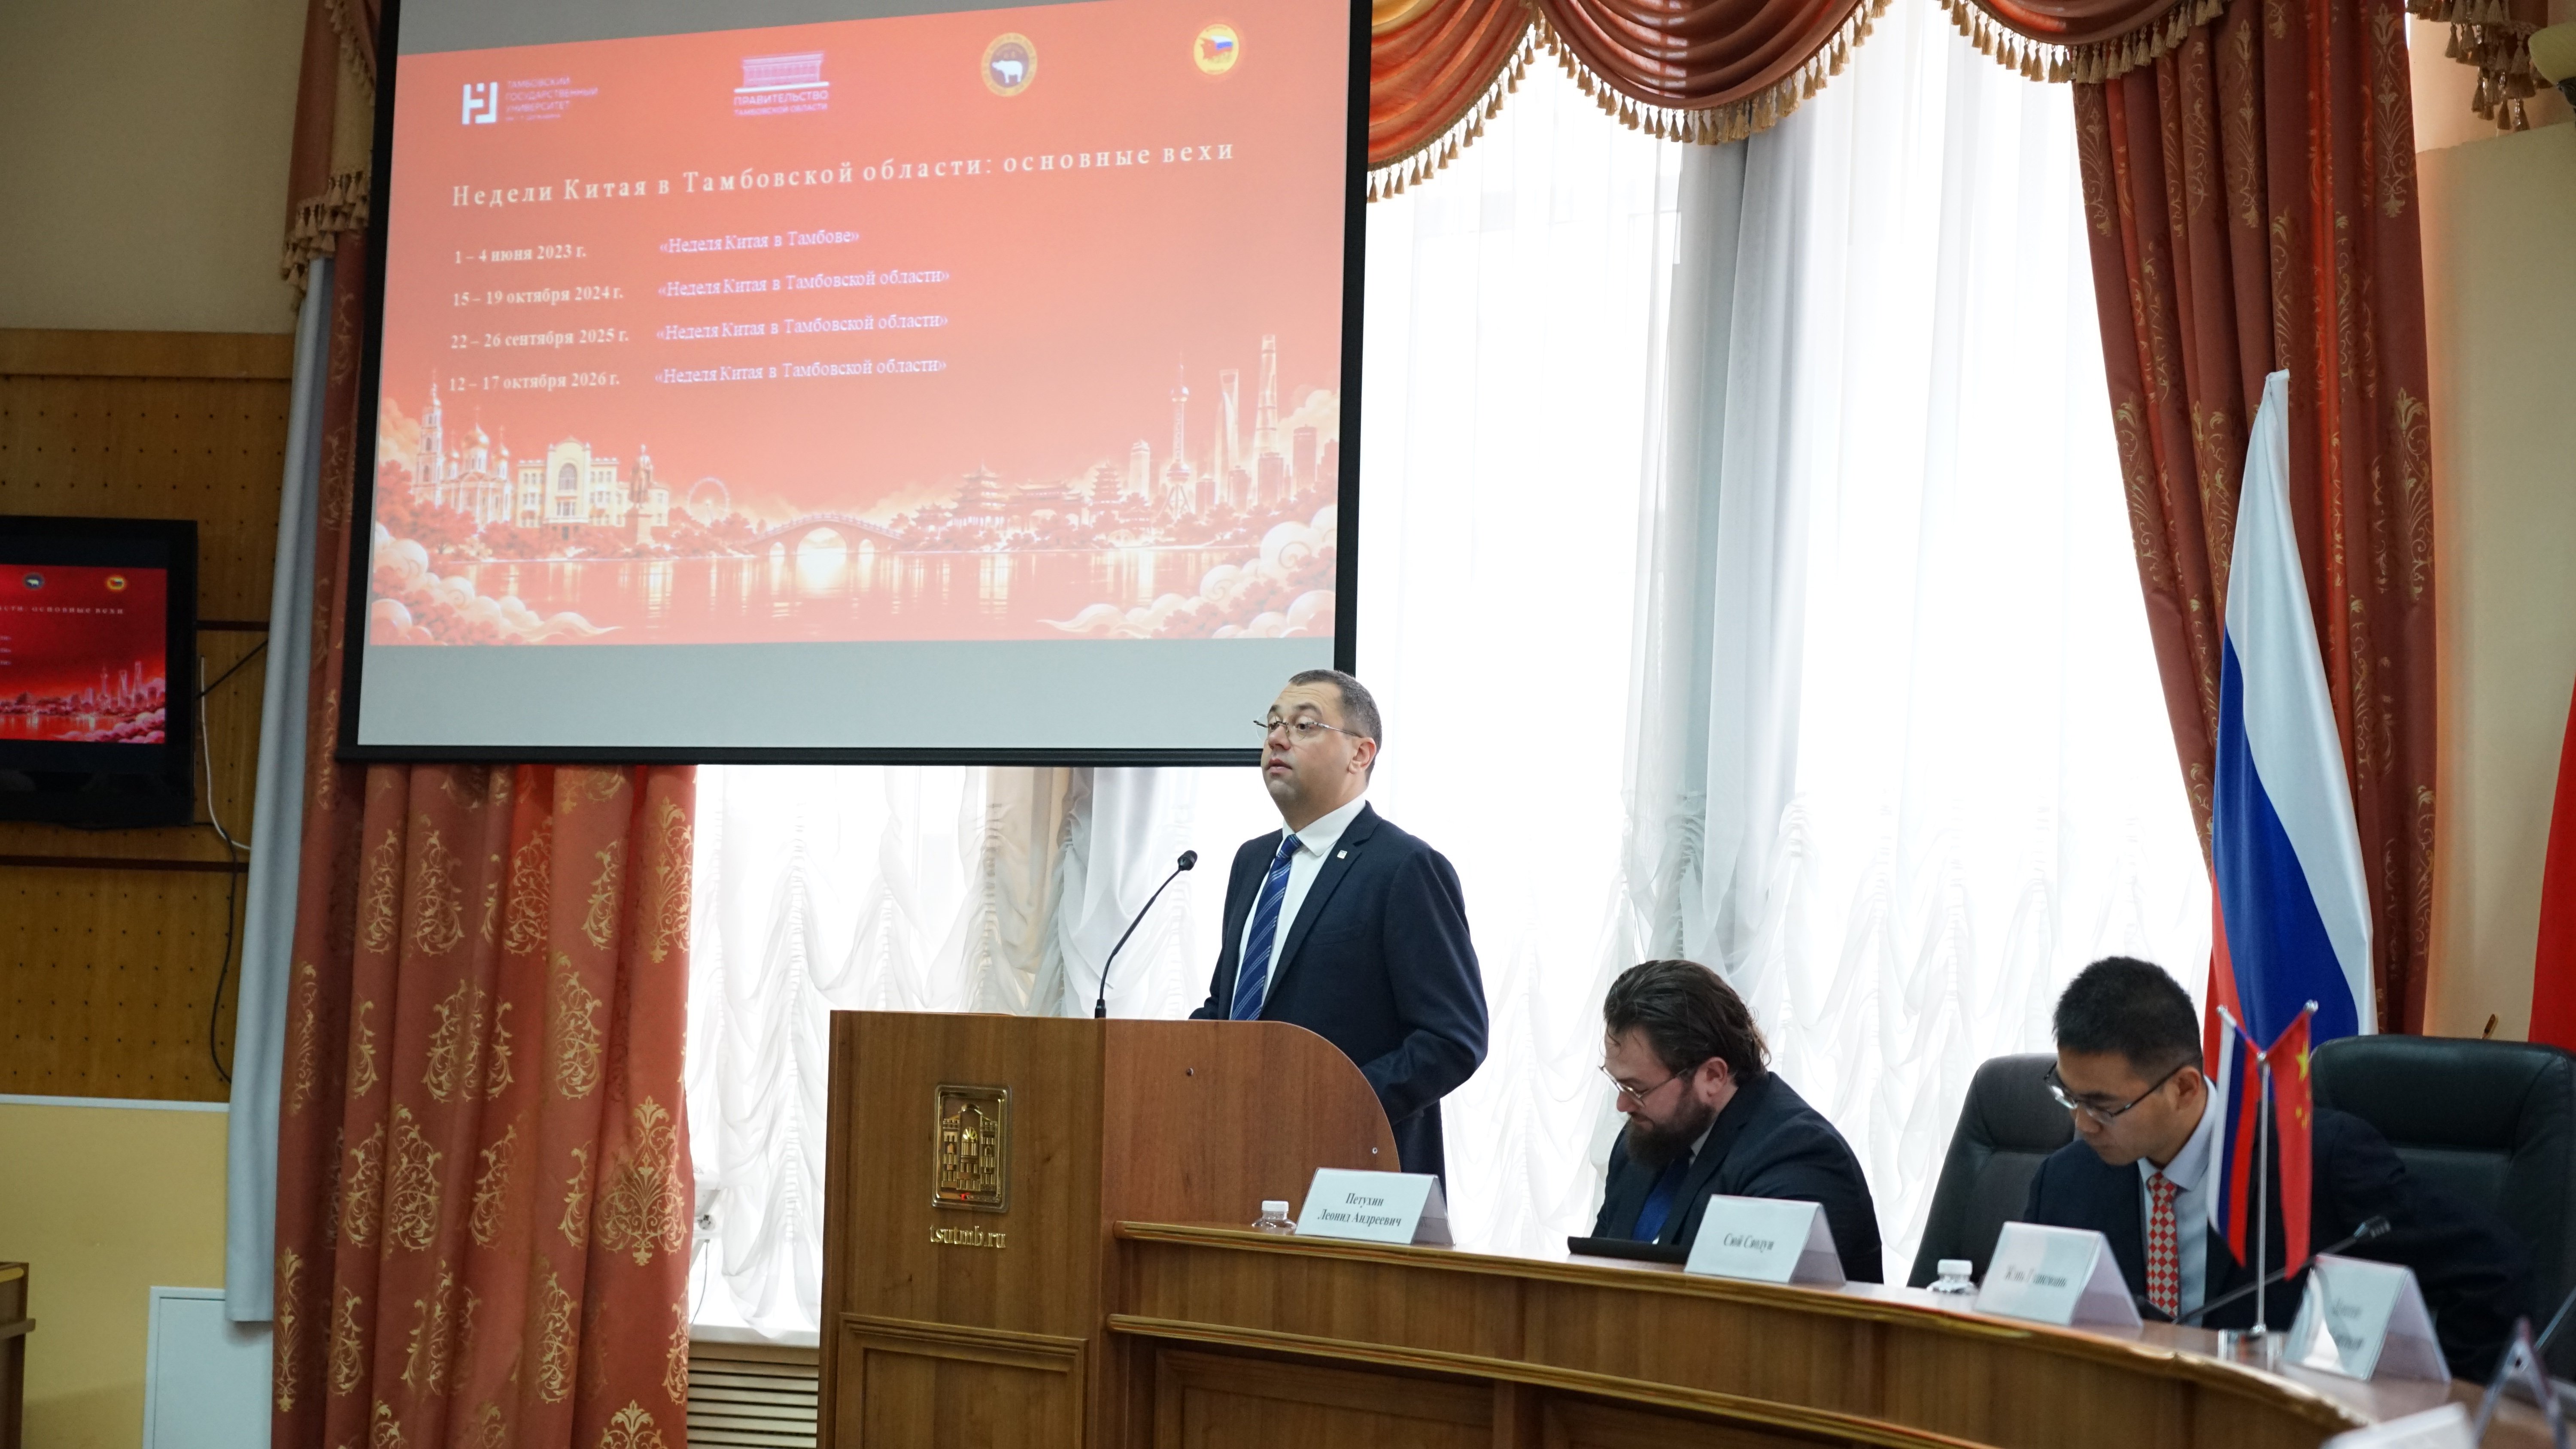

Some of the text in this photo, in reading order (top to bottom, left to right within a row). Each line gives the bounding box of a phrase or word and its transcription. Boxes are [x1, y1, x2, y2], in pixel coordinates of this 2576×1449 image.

[734, 90, 829, 106] ПРАВИТЕЛЬСТВО
[453, 144, 1234, 208] Недели Китая в Тамбовской области: основные вехи
[659, 229, 859, 254] «Неделя Китая в Тамбове»
[455, 250, 462, 264] 1
[478, 249, 487, 262] 4
[491, 249, 532, 262] июня
[537, 244, 573, 260] 2023
[576, 246, 587, 258] г.
[658, 269, 949, 297] «Неделя Китая в Тамбовской области»
[453, 291, 470, 306] 15
[486, 290, 503, 305] 19
[506, 288, 570, 306] октября
[575, 285, 610, 301] 2024
[613, 286, 624, 299] г.
[656, 314, 948, 340] «Неделя Китая в Тамбовской области»
[451, 334, 468, 349] 22
[484, 333, 501, 348] 26
[505, 330, 574, 349] сентября
[579, 328, 614, 343] 2025
[618, 329, 629, 342] г.
[450, 377, 465, 391] 12
[483, 375, 500, 390] 17
[503, 373, 567, 391] октября
[571, 371, 607, 387] 2026
[609, 373, 620, 386] г.
[655, 358, 947, 384] «Неделя Китая в Тамбовской области»
[1345, 1193, 1384, 1208] Петухин
[1318, 1209, 1402, 1227] Леонид Андреевич
[930, 1225, 1006, 1248] tsutmb.ru
